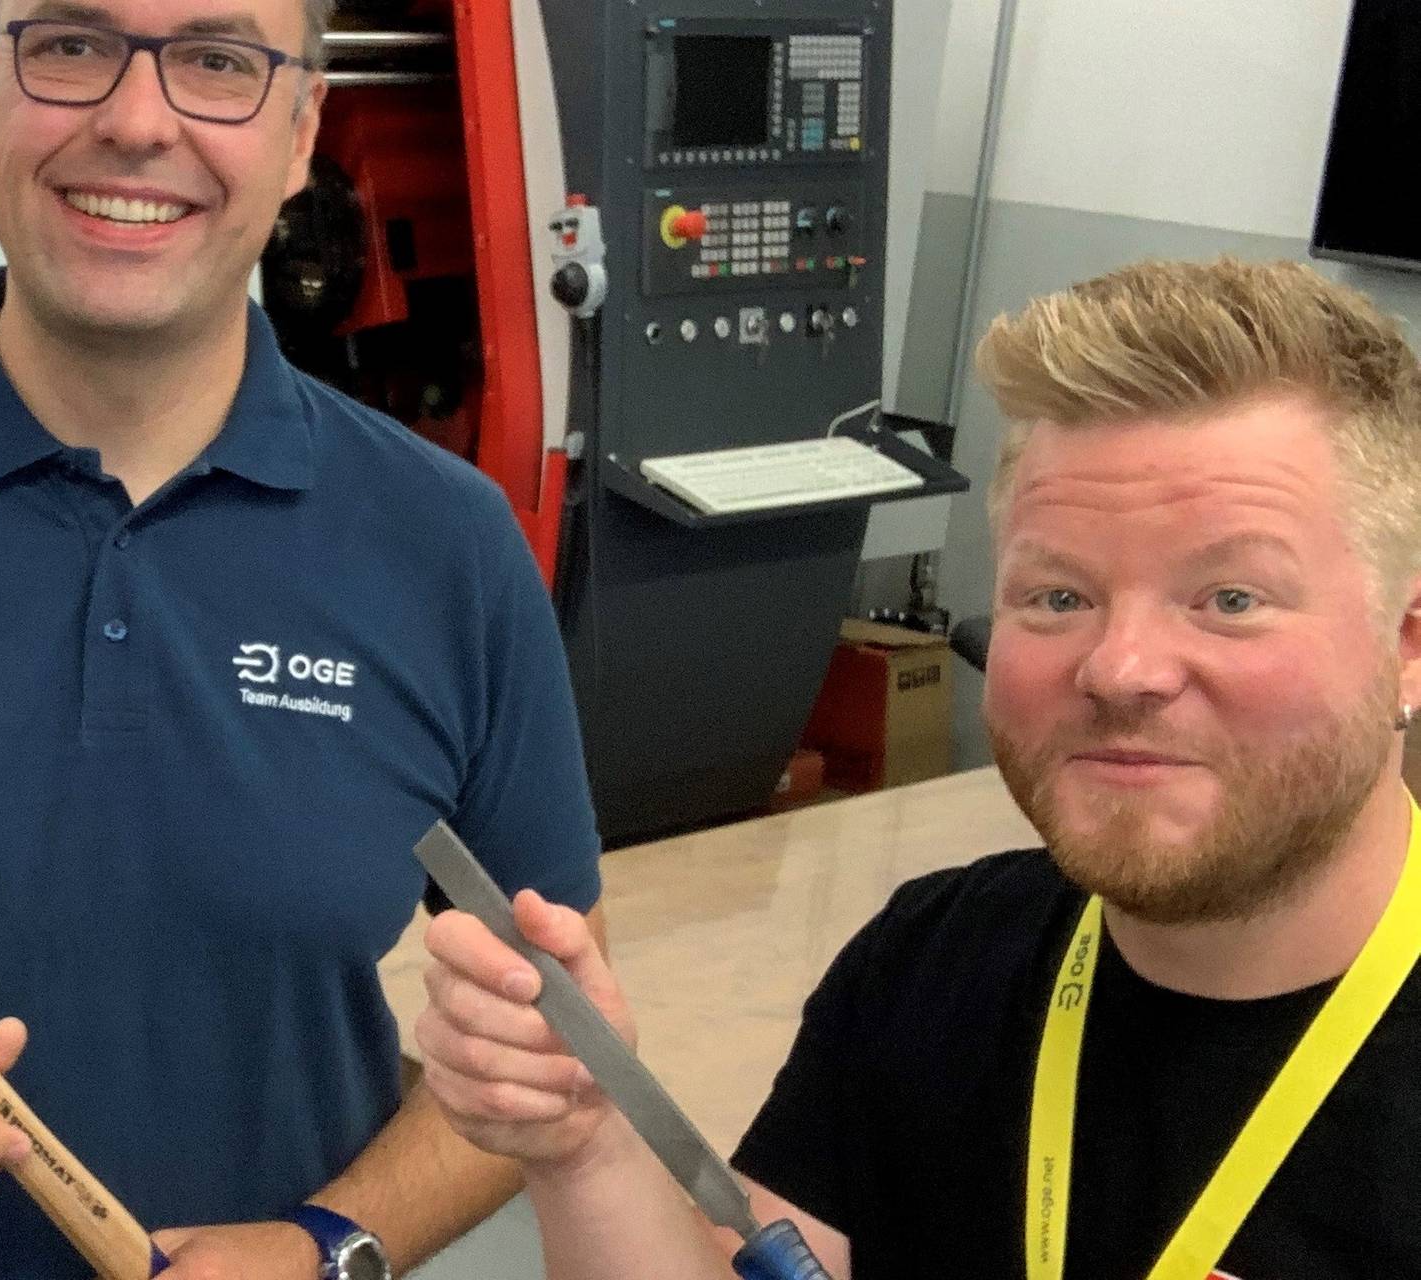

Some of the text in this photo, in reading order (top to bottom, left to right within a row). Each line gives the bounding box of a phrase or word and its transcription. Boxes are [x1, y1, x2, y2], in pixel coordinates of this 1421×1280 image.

[288, 654, 355, 686] OGE
[239, 687, 352, 721] Team Ausbildung
[1070, 933, 1091, 976] OGE
[1040, 1156, 1054, 1263] www.oge.net
